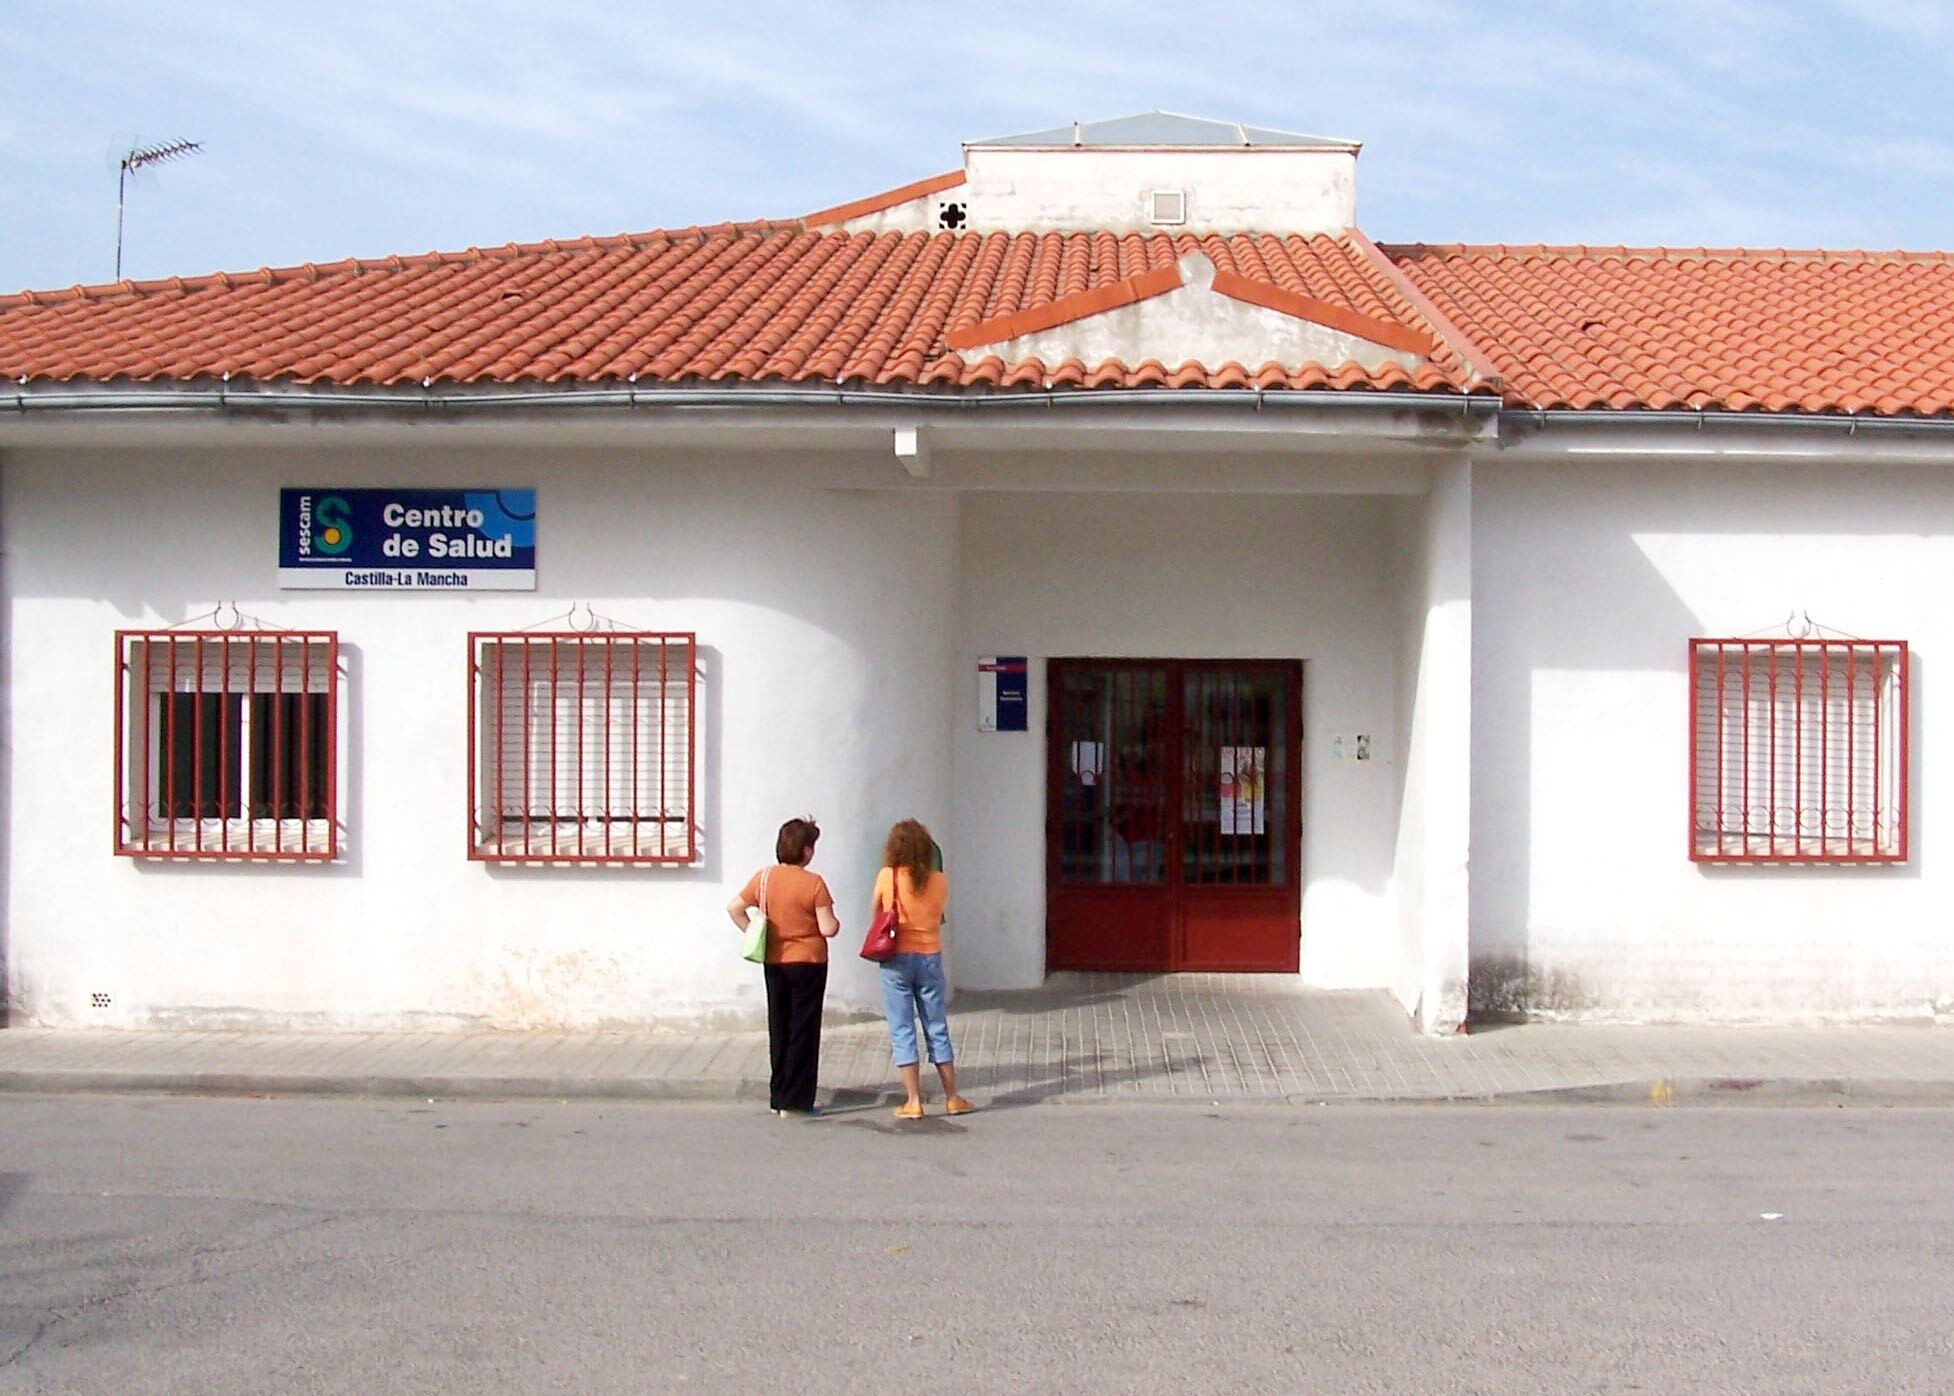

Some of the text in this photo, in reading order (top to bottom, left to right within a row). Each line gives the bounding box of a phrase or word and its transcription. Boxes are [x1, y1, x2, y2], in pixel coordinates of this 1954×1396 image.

[299, 496, 312, 555] sescam
[383, 503, 484, 528] Centro
[382, 533, 512, 558] de Salud
[345, 571, 468, 587] Castilla-La Mancha
